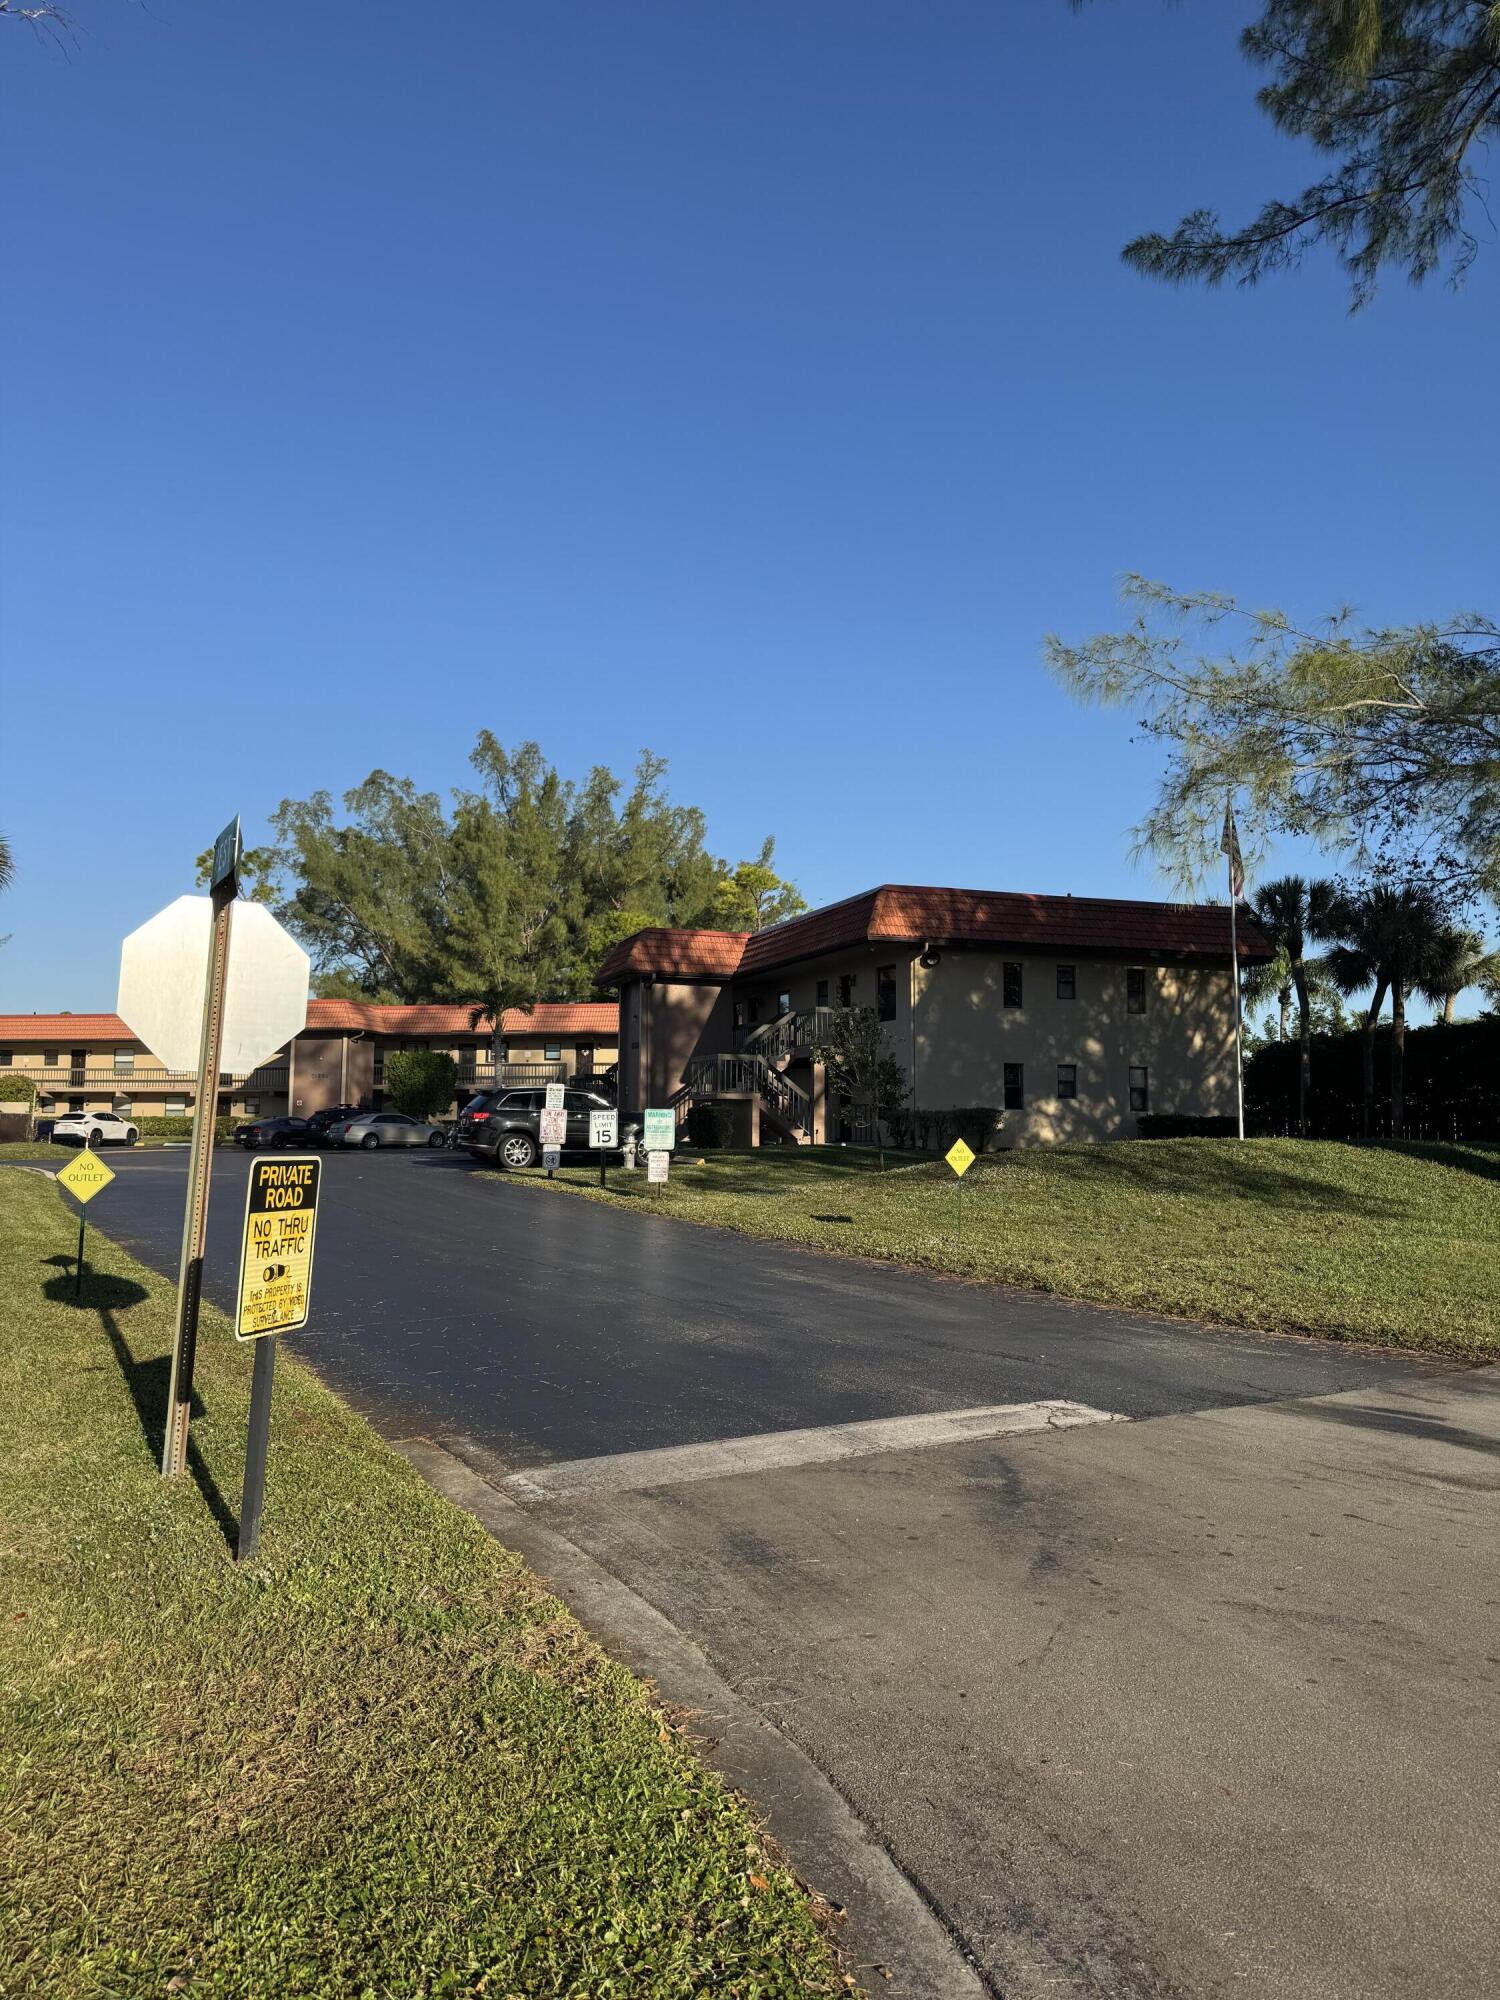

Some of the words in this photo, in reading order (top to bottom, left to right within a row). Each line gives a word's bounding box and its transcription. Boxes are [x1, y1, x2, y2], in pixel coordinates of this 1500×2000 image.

[596, 1130, 611, 1143] 15
[68, 1173, 104, 1182] OUTLET
[79, 1163, 94, 1171] NO
[259, 1165, 313, 1186] PRIVATE
[265, 1187, 303, 1208] ROAD
[254, 1219, 271, 1238] NO
[278, 1216, 308, 1236] THRU
[255, 1236, 304, 1258] TRAFFIC
[250, 1289, 263, 1302] THIS
[264, 1284, 295, 1299] PROPERTY
[296, 1282, 302, 1293] IS
[243, 1300, 277, 1316] PROTECTED
[278, 1297, 287, 1310] BY
[289, 1294, 305, 1307] VIDEO
